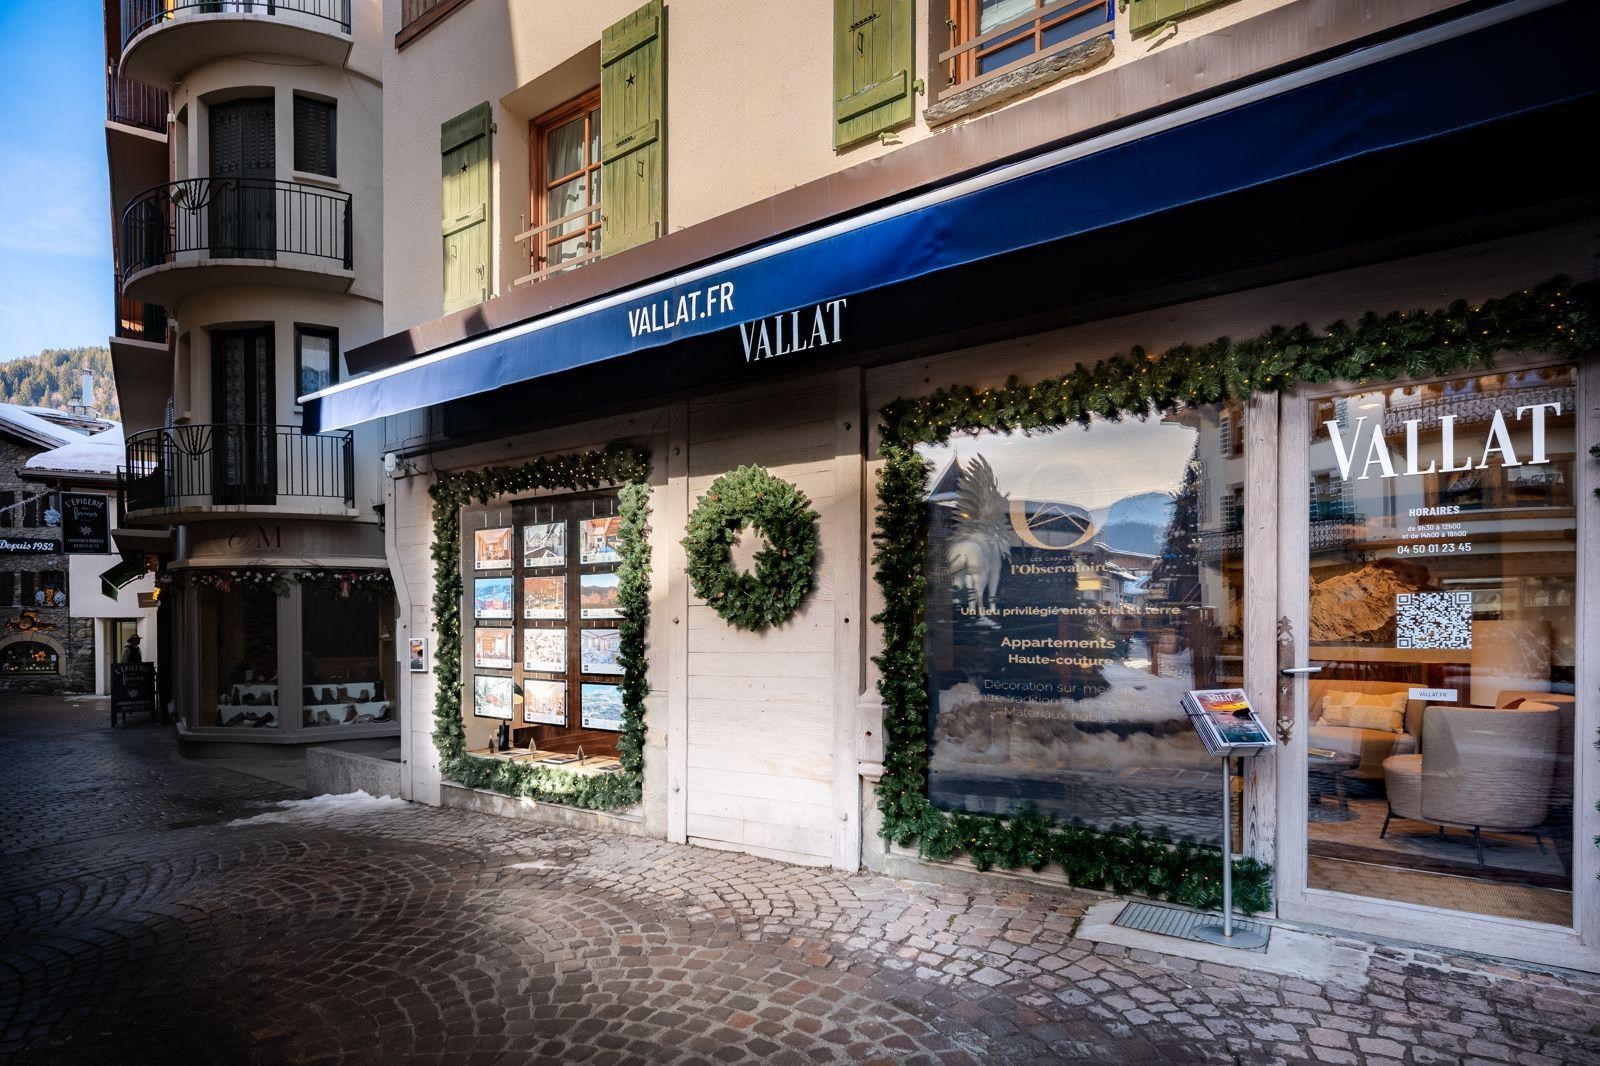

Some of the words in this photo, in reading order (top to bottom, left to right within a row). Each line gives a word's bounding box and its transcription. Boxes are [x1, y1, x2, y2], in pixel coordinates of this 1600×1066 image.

[628, 281, 734, 338] VALLAT.FR
[739, 299, 847, 363] VALLAT
[1322, 401, 1562, 482] VALLAT
[1408, 505, 1460, 517] HORAIRES
[0, 539, 31, 551] Depuis
[32, 541, 54, 551] 1952
[1397, 545, 1410, 554] 04
[1412, 544, 1426, 554] 50
[1428, 544, 1438, 553] 01
[1442, 543, 1455, 552] 23
[1458, 542, 1472, 552] 45
[1010, 562, 1109, 575] l'Observatoire
[960, 607, 976, 616] Un
[979, 606, 1000, 616] lieu
[1003, 605, 1059, 618] privilégié
[1061, 607, 1096, 615] entre
[1100, 605, 1125, 615] ciel
[1128, 606, 1142, 615] et
[1146, 606, 1182, 615] terre
[1000, 636, 1116, 650] Appartements
[1008, 654, 1114, 666] Haute-couture
